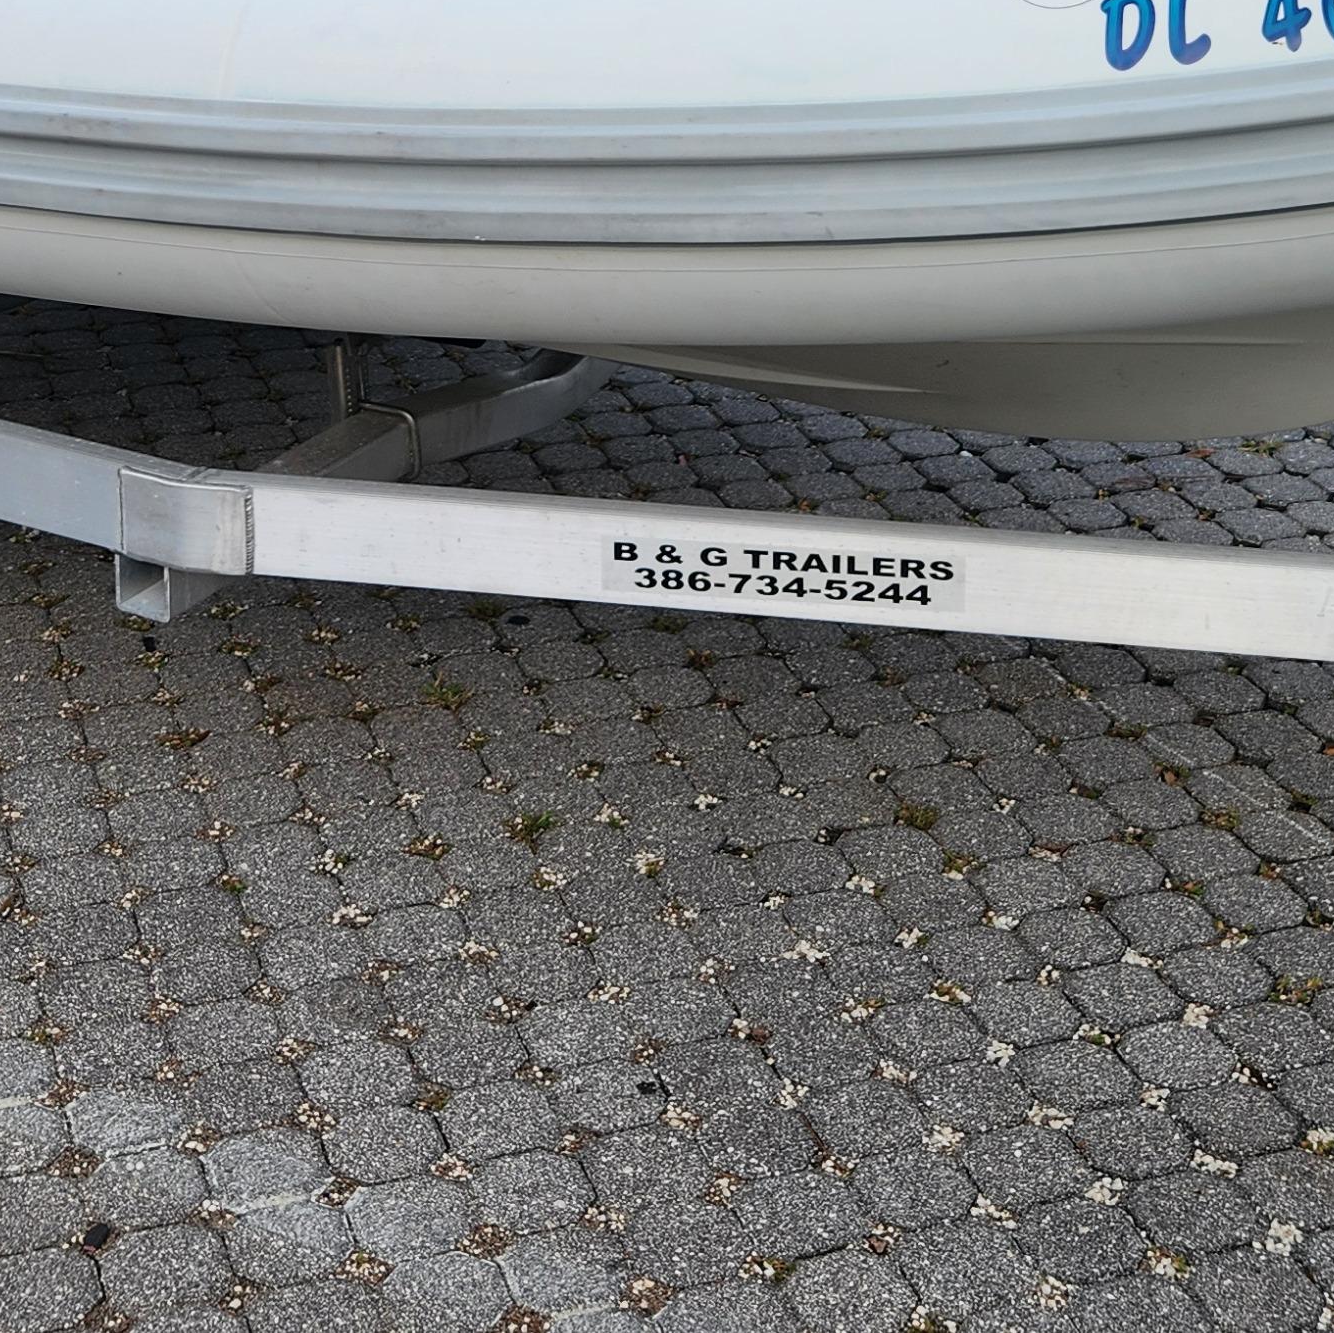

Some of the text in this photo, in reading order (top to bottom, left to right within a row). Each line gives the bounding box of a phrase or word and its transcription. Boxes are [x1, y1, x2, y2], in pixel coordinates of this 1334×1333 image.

[613, 541, 954, 581] B & G TRAILERS
[634, 567, 932, 606] 386-734-5244
